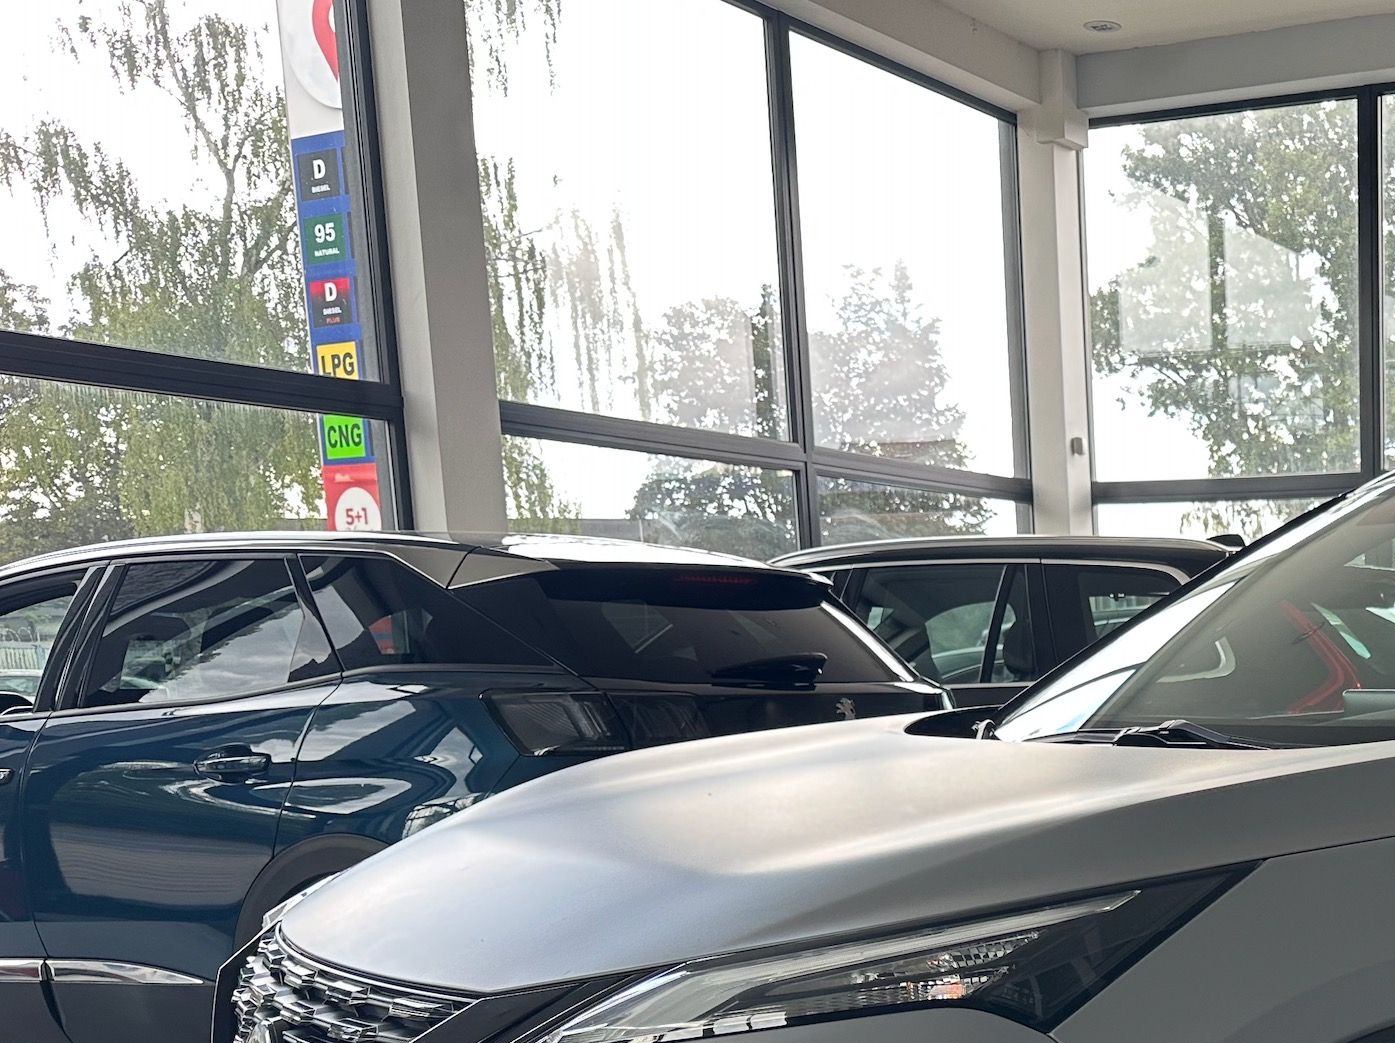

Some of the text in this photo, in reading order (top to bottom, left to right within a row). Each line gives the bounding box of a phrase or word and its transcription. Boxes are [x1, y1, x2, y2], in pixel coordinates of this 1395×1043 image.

[312, 159, 326, 179] D
[311, 184, 331, 194] DIESEL
[314, 222, 336, 243] 95
[314, 247, 340, 257] NATURAL
[324, 282, 337, 302] D
[323, 307, 342, 316] DIESEL
[321, 352, 355, 377] LPG
[327, 423, 362, 449] CNG
[345, 507, 368, 525] 5+1
